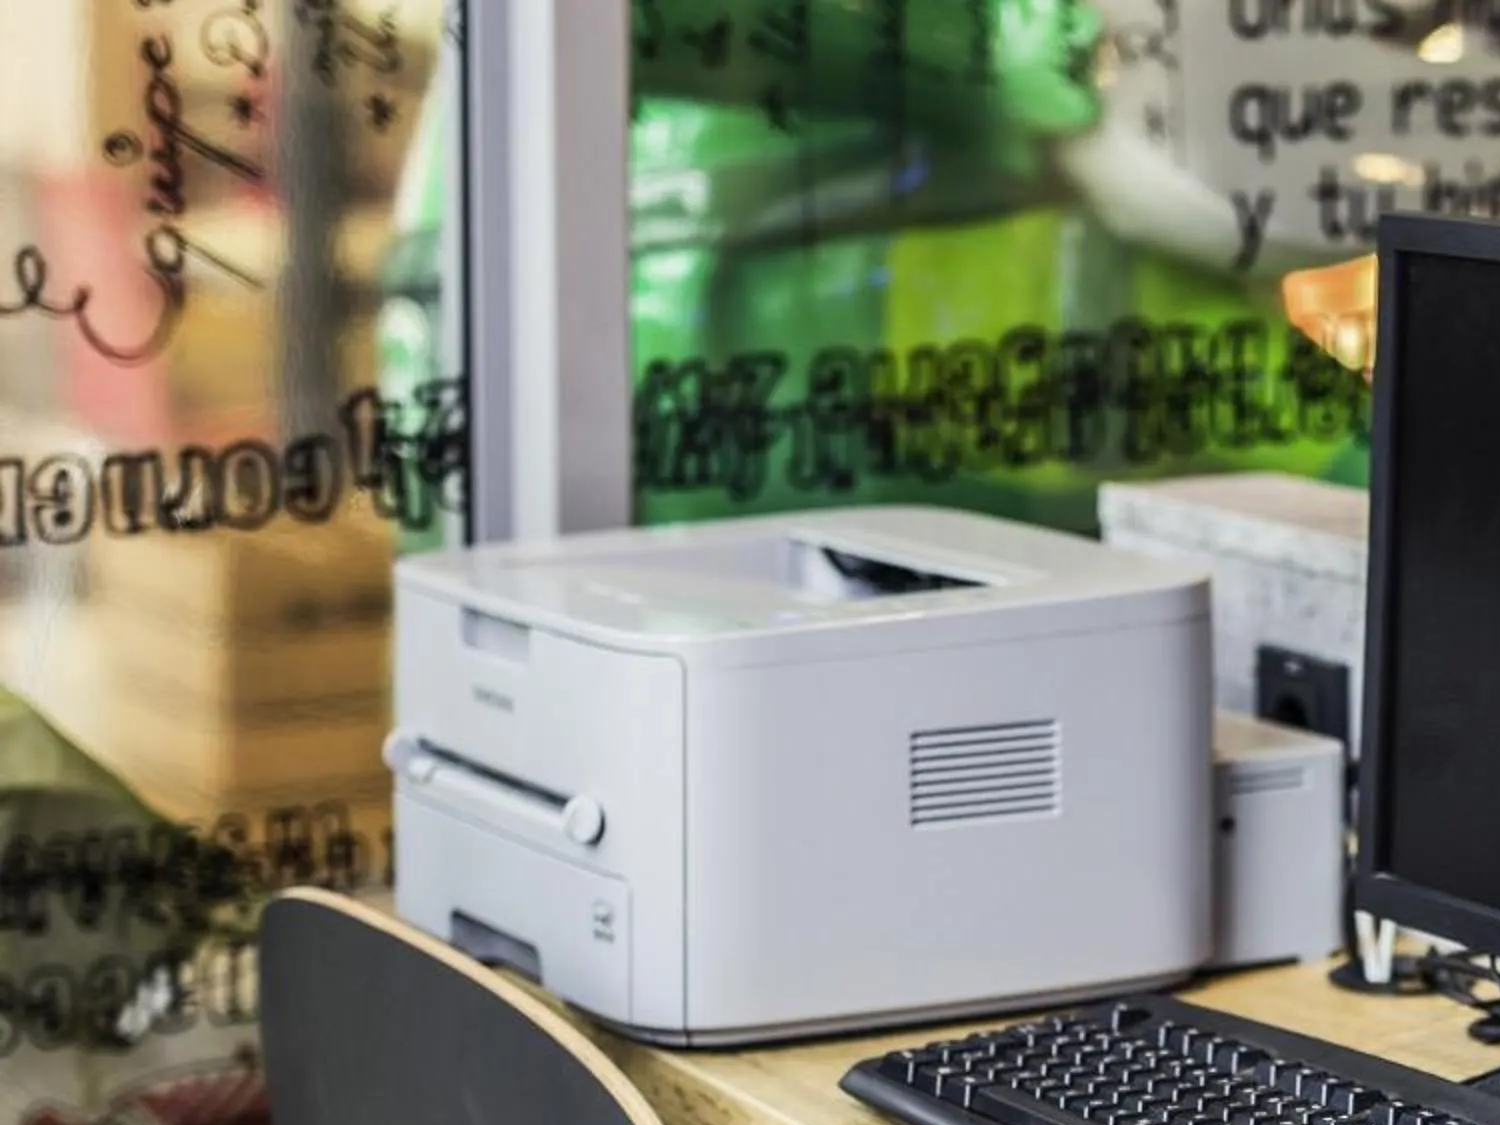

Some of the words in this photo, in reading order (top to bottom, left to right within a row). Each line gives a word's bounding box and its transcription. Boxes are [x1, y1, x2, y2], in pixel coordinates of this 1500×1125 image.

[1228, 80, 1362, 160] que
[1230, 187, 1276, 271] y
[1309, 164, 1382, 241] tu
